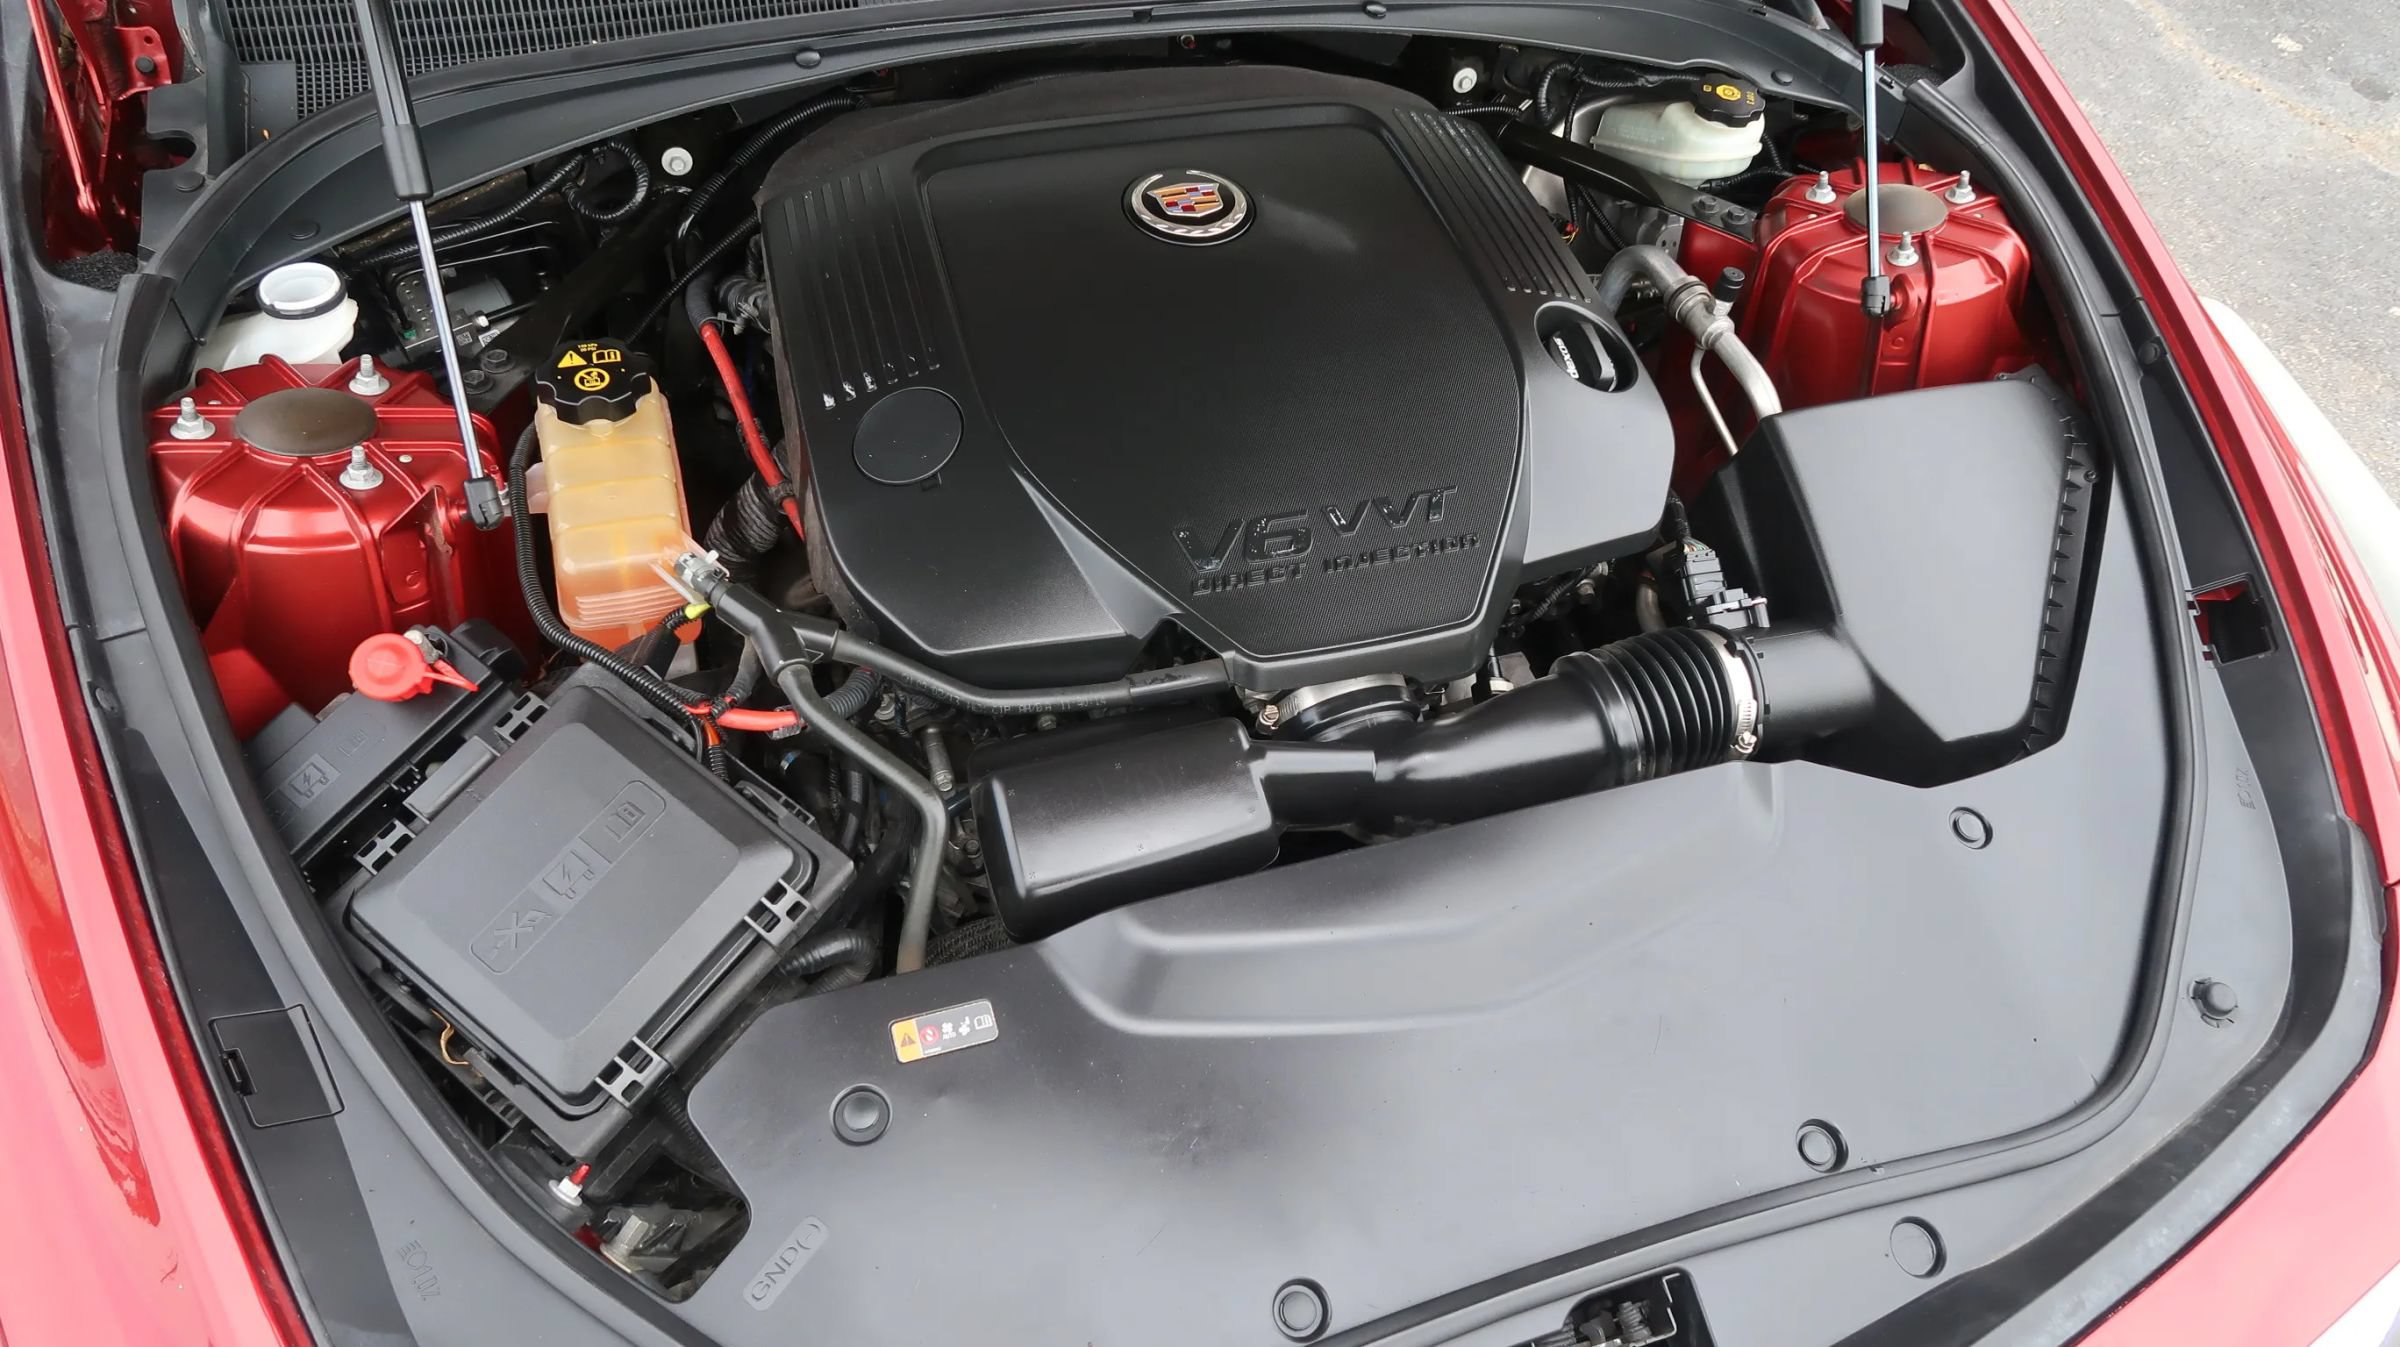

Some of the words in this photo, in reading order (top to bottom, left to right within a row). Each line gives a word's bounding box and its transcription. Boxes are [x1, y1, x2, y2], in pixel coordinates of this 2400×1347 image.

[1552, 336, 1579, 379] dexos
[1172, 509, 1314, 573] V6
[1322, 485, 1458, 536] VVT
[1191, 562, 1307, 596] DIRECT
[1324, 533, 1480, 574] INJECTION
